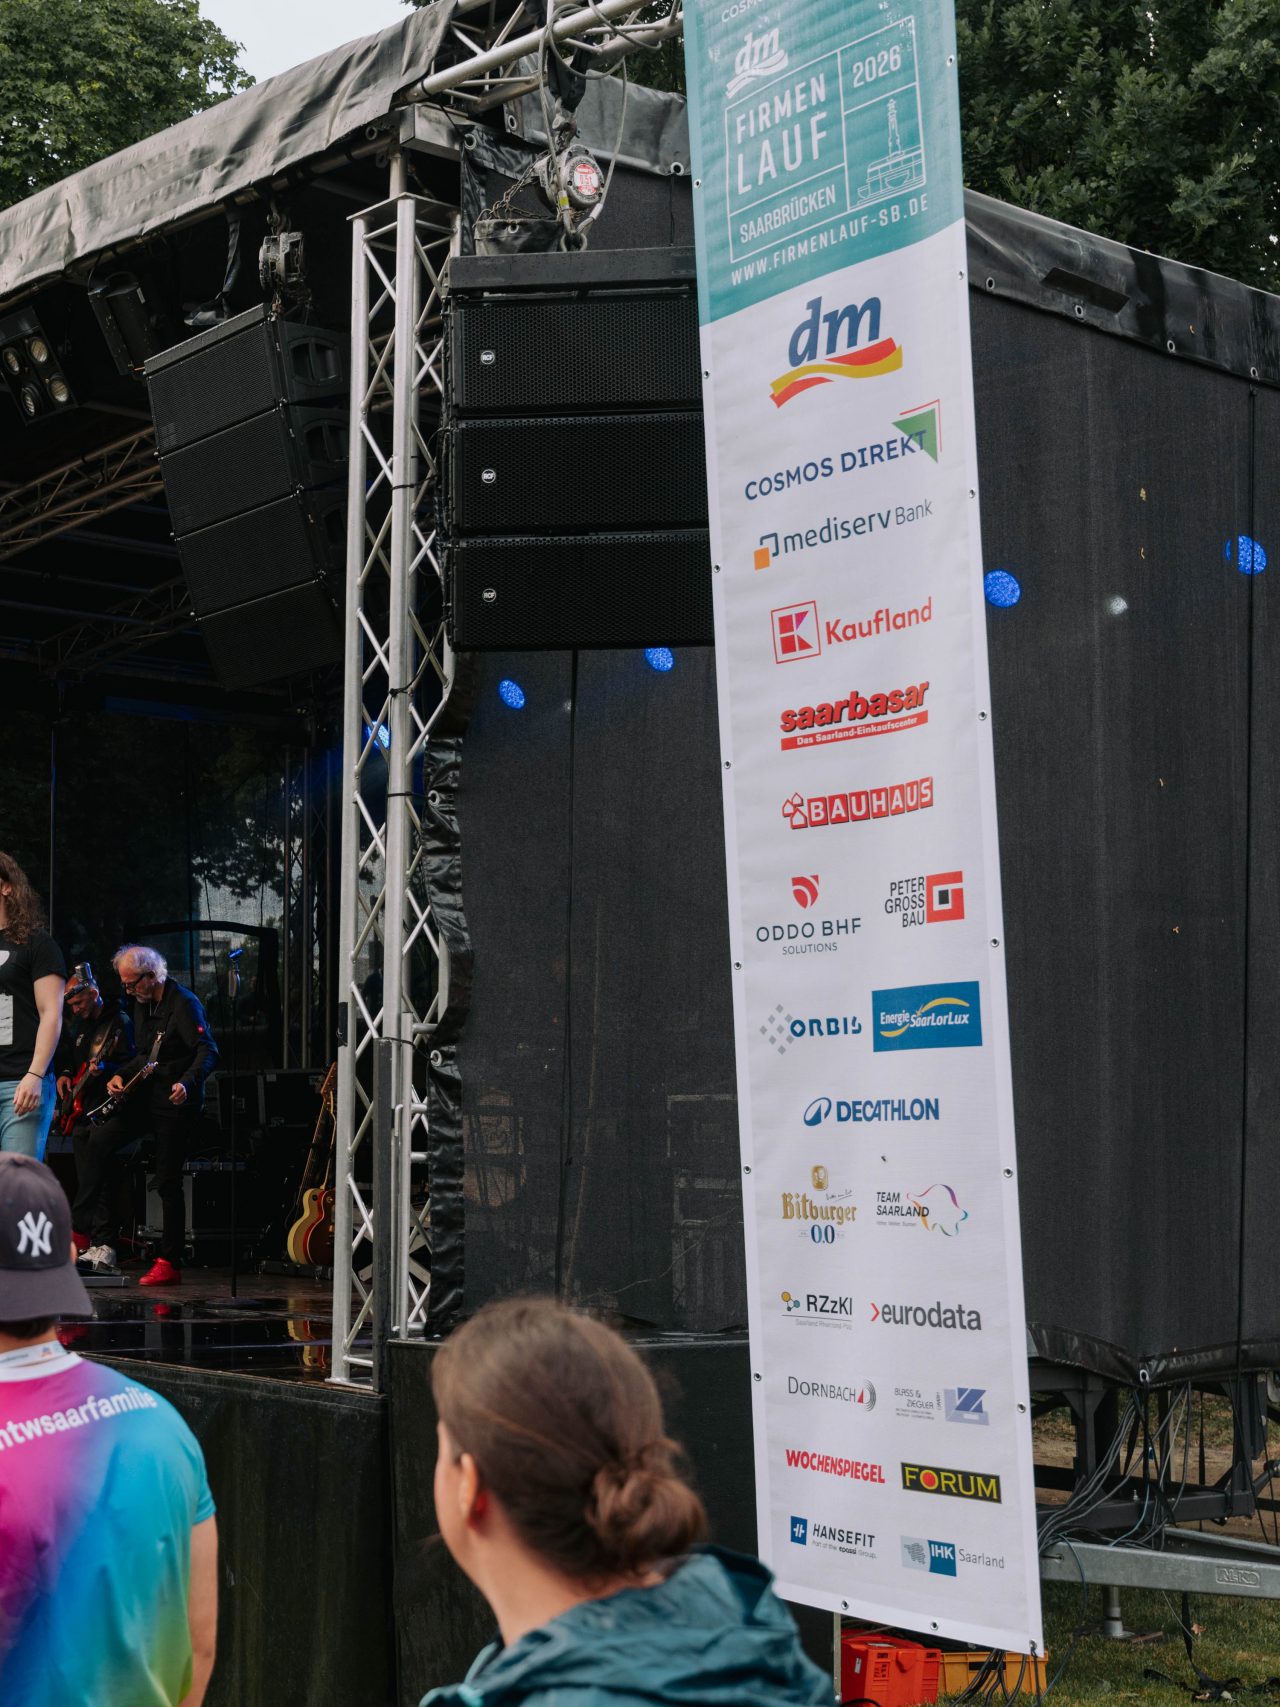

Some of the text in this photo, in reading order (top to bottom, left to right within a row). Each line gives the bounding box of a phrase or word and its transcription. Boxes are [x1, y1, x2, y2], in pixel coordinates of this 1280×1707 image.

[735, 28, 780, 74] dm
[852, 45, 902, 88] 2026
[736, 72, 826, 144] FIRMEN
[738, 111, 827, 195] LAUF
[739, 184, 836, 243] SAARBRÜCKEN
[731, 194, 929, 286] WWW.FIRMENLAUF-SB.DE
[788, 296, 881, 367] dm
[745, 429, 927, 500] COSMOS DIREKT
[783, 499, 933, 554] mediserv Bank
[825, 596, 932, 645] Kaufland
[780, 681, 929, 732] saarbasar
[797, 716, 918, 746] Das Saarland-Einkaufscenter
[810, 779, 933, 822] BAUHAUS
[890, 876, 925, 897] PETER
[884, 892, 925, 914] GROSS
[756, 918, 861, 942] ODDO BHF
[902, 910, 925, 928] BAU
[782, 942, 838, 956] SOLUTIONS
[790, 1016, 862, 1037] ORBIS
[880, 1011, 969, 1028] Energie SaarLorLux
[836, 1098, 939, 1122] DECATHLON
[782, 1192, 857, 1226] Bitburger
[876, 1205, 930, 1217] SAARLAND
[877, 1192, 900, 1203] TEAM
[17, 1211, 53, 1257] NY
[811, 1224, 835, 1244] 0.0
[806, 1294, 853, 1316] RZzKI
[881, 1301, 982, 1331] eurodata
[907, 1399, 934, 1409] ZIEGLER
[785, 1449, 886, 1484] WOCHENSPIEGEL
[904, 1466, 998, 1499] FORUM
[813, 1523, 875, 1548] HANSEFIT
[931, 1545, 1005, 1569] IHK Saarland
